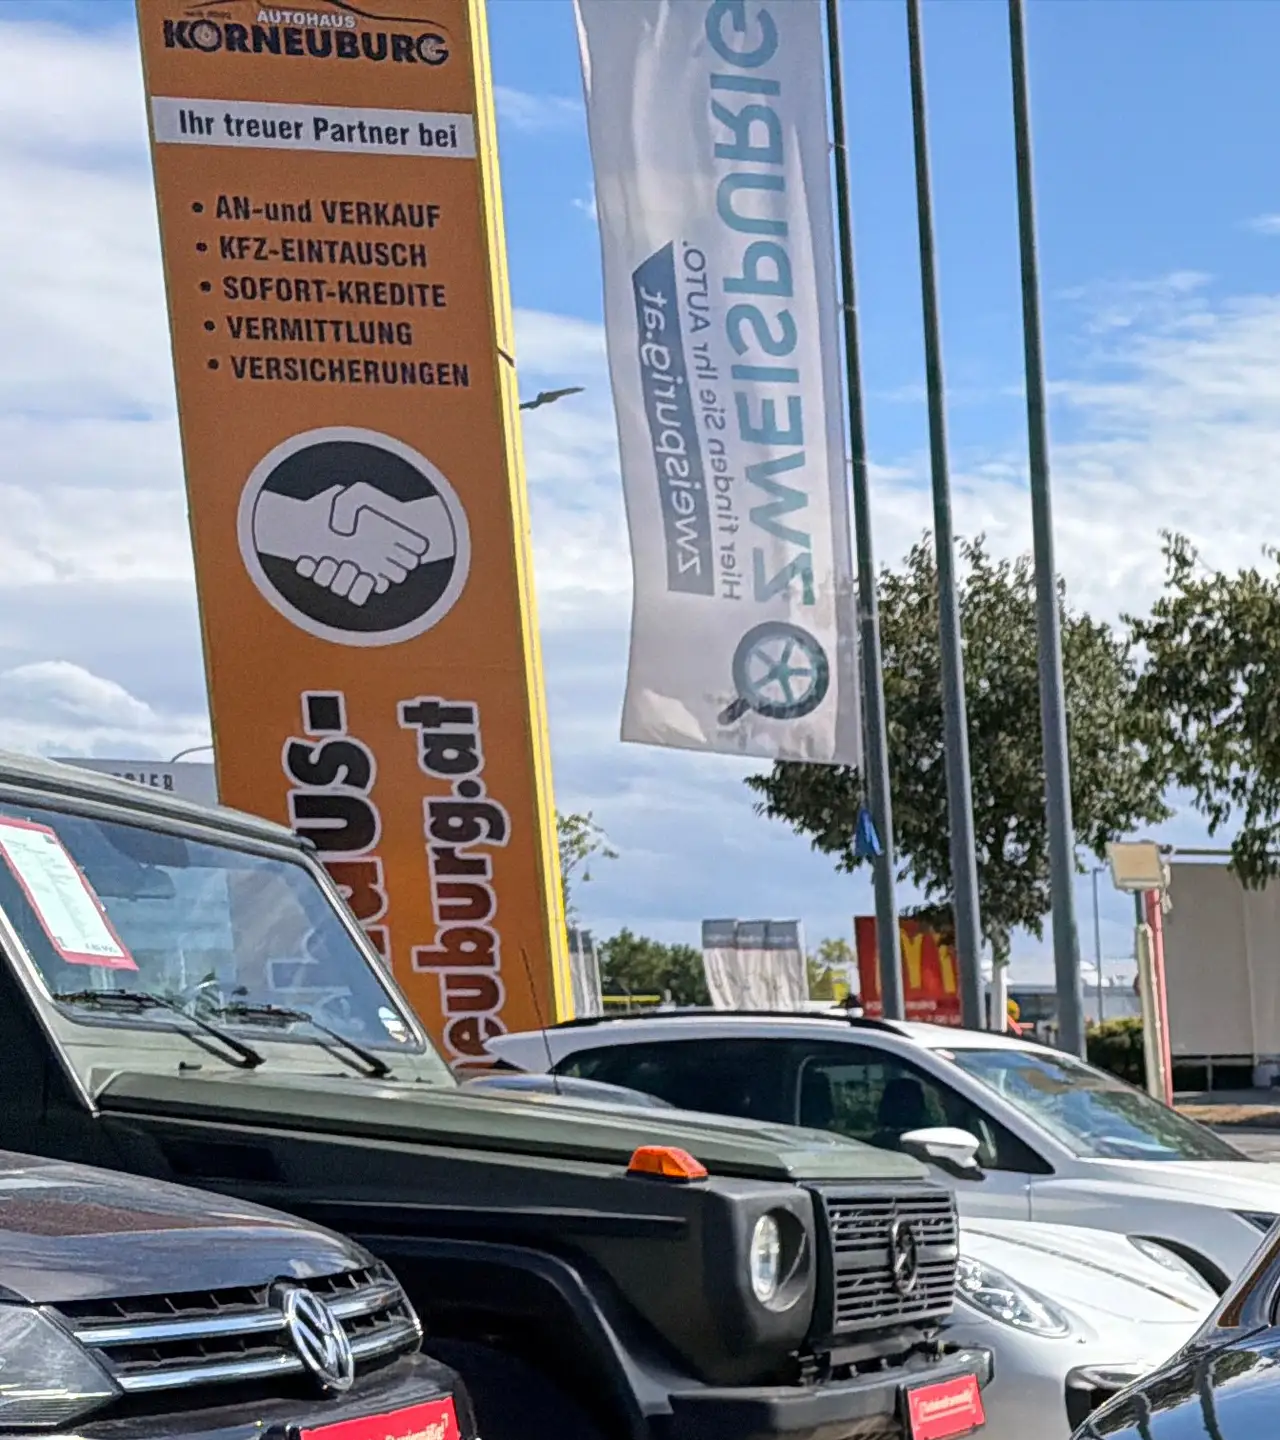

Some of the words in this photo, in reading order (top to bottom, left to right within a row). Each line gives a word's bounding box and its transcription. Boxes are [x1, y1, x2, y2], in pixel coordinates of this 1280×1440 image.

[257, 9, 357, 29] AUTOHAUS
[163, 19, 449, 65] KORNEUBURG
[179, 110, 215, 136] Ihr
[223, 113, 303, 140] treuer
[312, 117, 410, 146] Partner
[419, 123, 457, 149] bei
[216, 195, 312, 223] AN-und
[321, 201, 441, 228] VERKAUF
[219, 236, 428, 268] KFZ-EINTAUSCH
[223, 276, 447, 308] SOFORT-KREDITE
[226, 316, 413, 345] VERMITTLUNG
[230, 356, 470, 387] VERSICHERUNGEN
